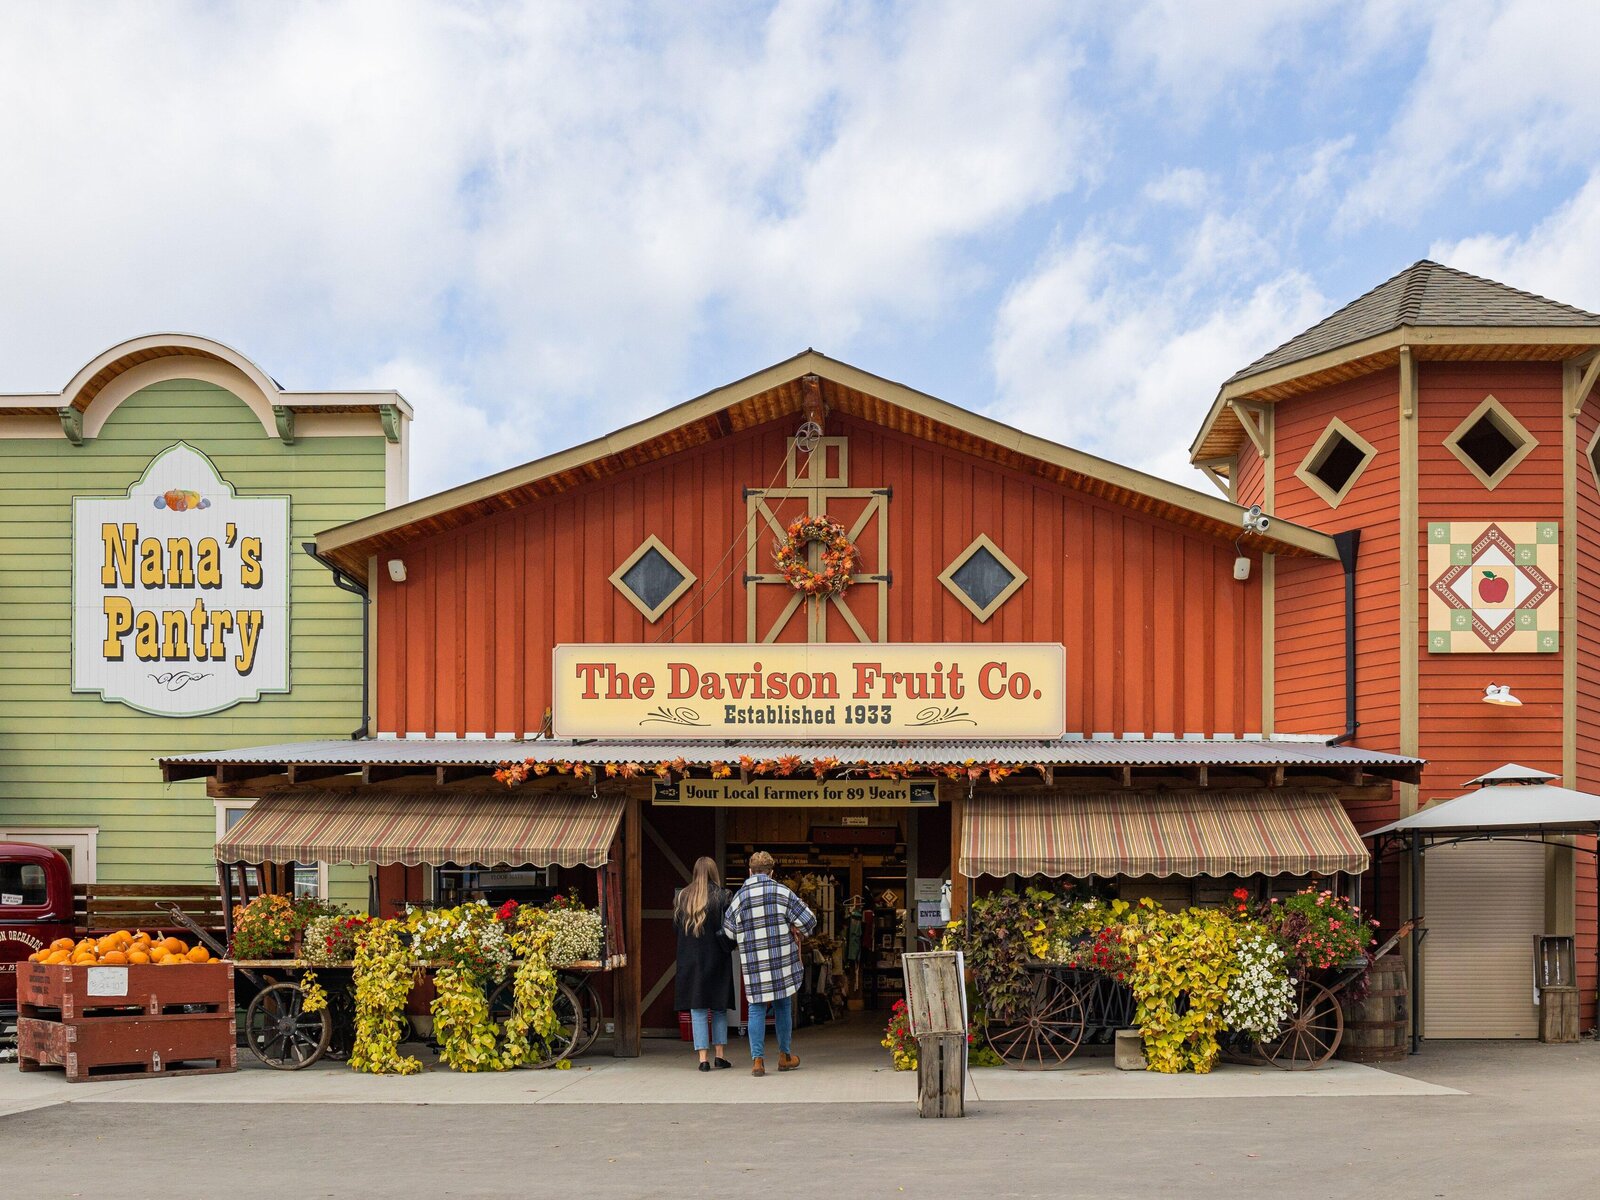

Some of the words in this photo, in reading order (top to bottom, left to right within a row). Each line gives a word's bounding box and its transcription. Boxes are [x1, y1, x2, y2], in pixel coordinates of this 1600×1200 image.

[101, 523, 262, 589] Nana's
[103, 596, 263, 676] Pantry
[576, 663, 655, 699] The
[667, 662, 840, 700] Davison
[852, 662, 965, 700] Fruit
[978, 662, 1042, 700] Co.
[724, 705, 836, 725] Established
[845, 705, 892, 724] 1933
[686, 785, 719, 799] Your
[724, 786, 759, 800] Local
[823, 786, 843, 800] for
[847, 787, 864, 800] 89
[869, 786, 907, 800] Years
[920, 910, 941, 918] ENTER
[8, 930, 44, 952] ORCHARDS
